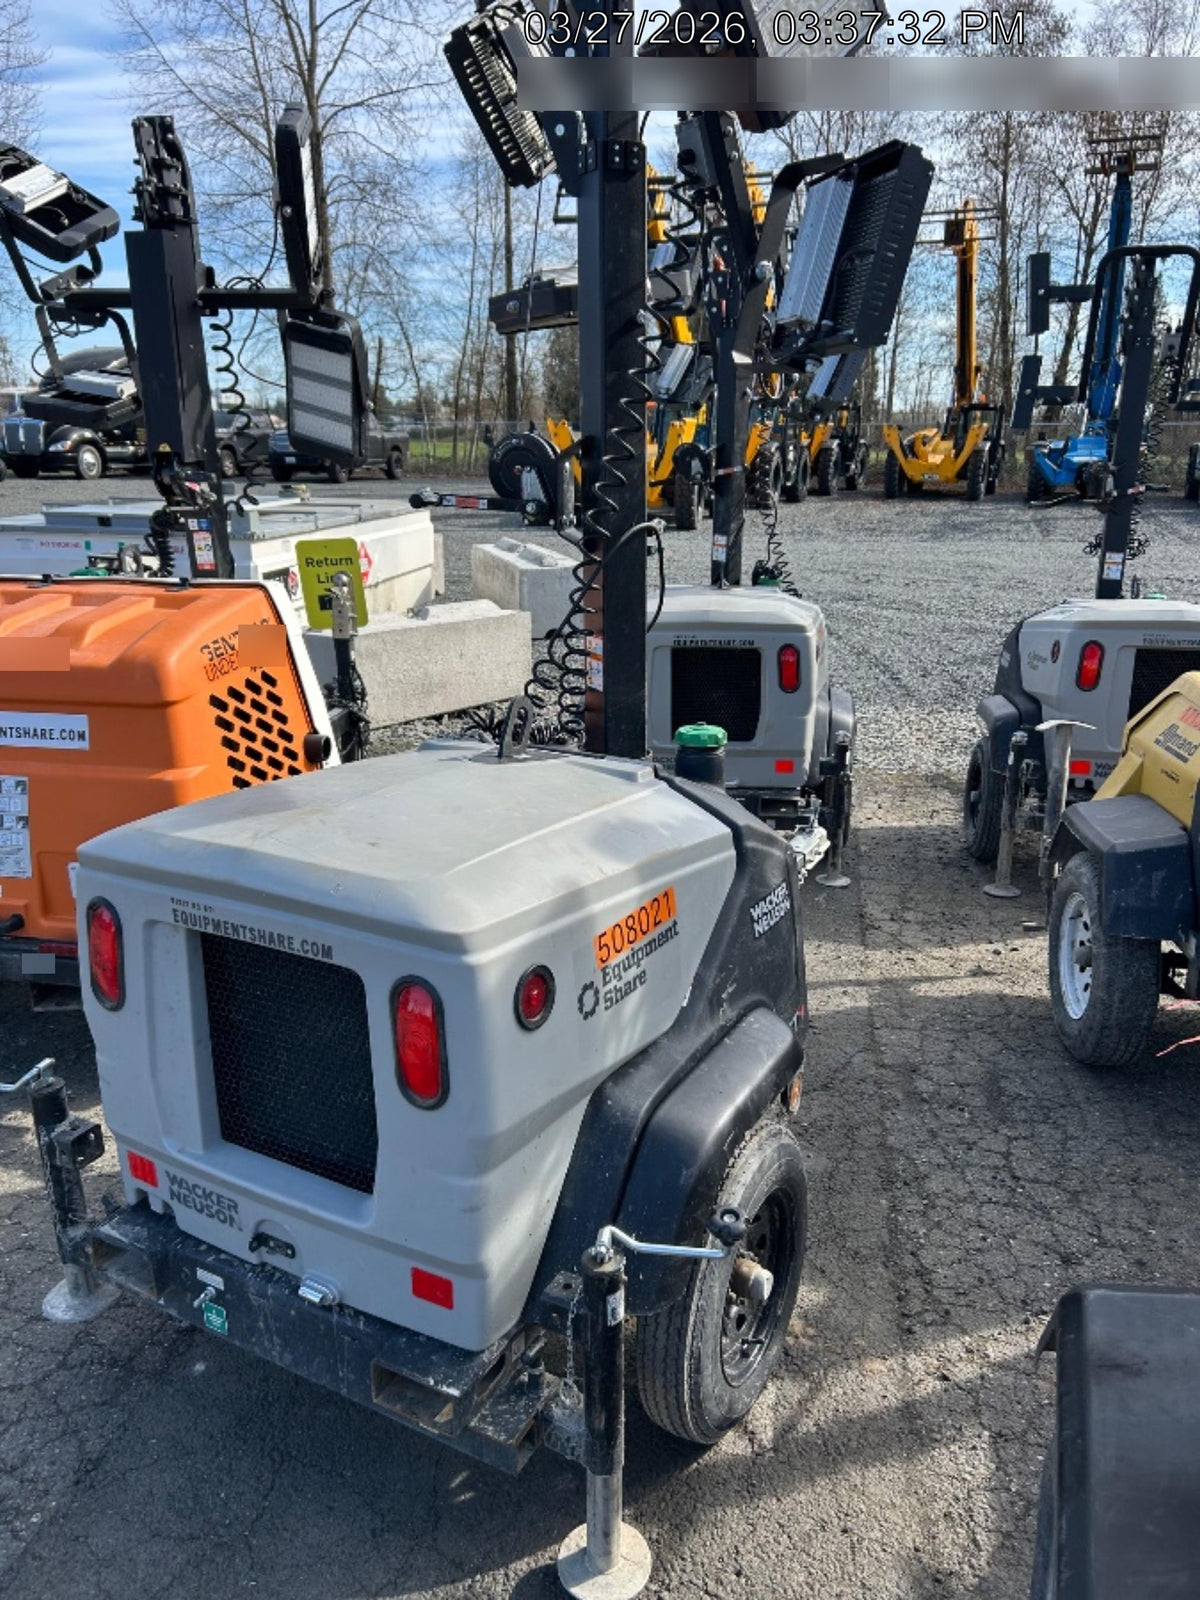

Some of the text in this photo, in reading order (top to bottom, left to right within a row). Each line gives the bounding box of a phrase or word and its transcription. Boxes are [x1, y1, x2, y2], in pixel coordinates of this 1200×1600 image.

[305, 556, 353, 568] Return
[750, 882, 788, 921] WACKER
[753, 896, 790, 938] NEUSON
[172, 908, 333, 960] EQUIPMENTSHARE.COM
[598, 890, 672, 963] 508021
[601, 919, 679, 987] Equipment
[603, 969, 648, 1011] Share
[165, 1169, 239, 1215] WACKER
